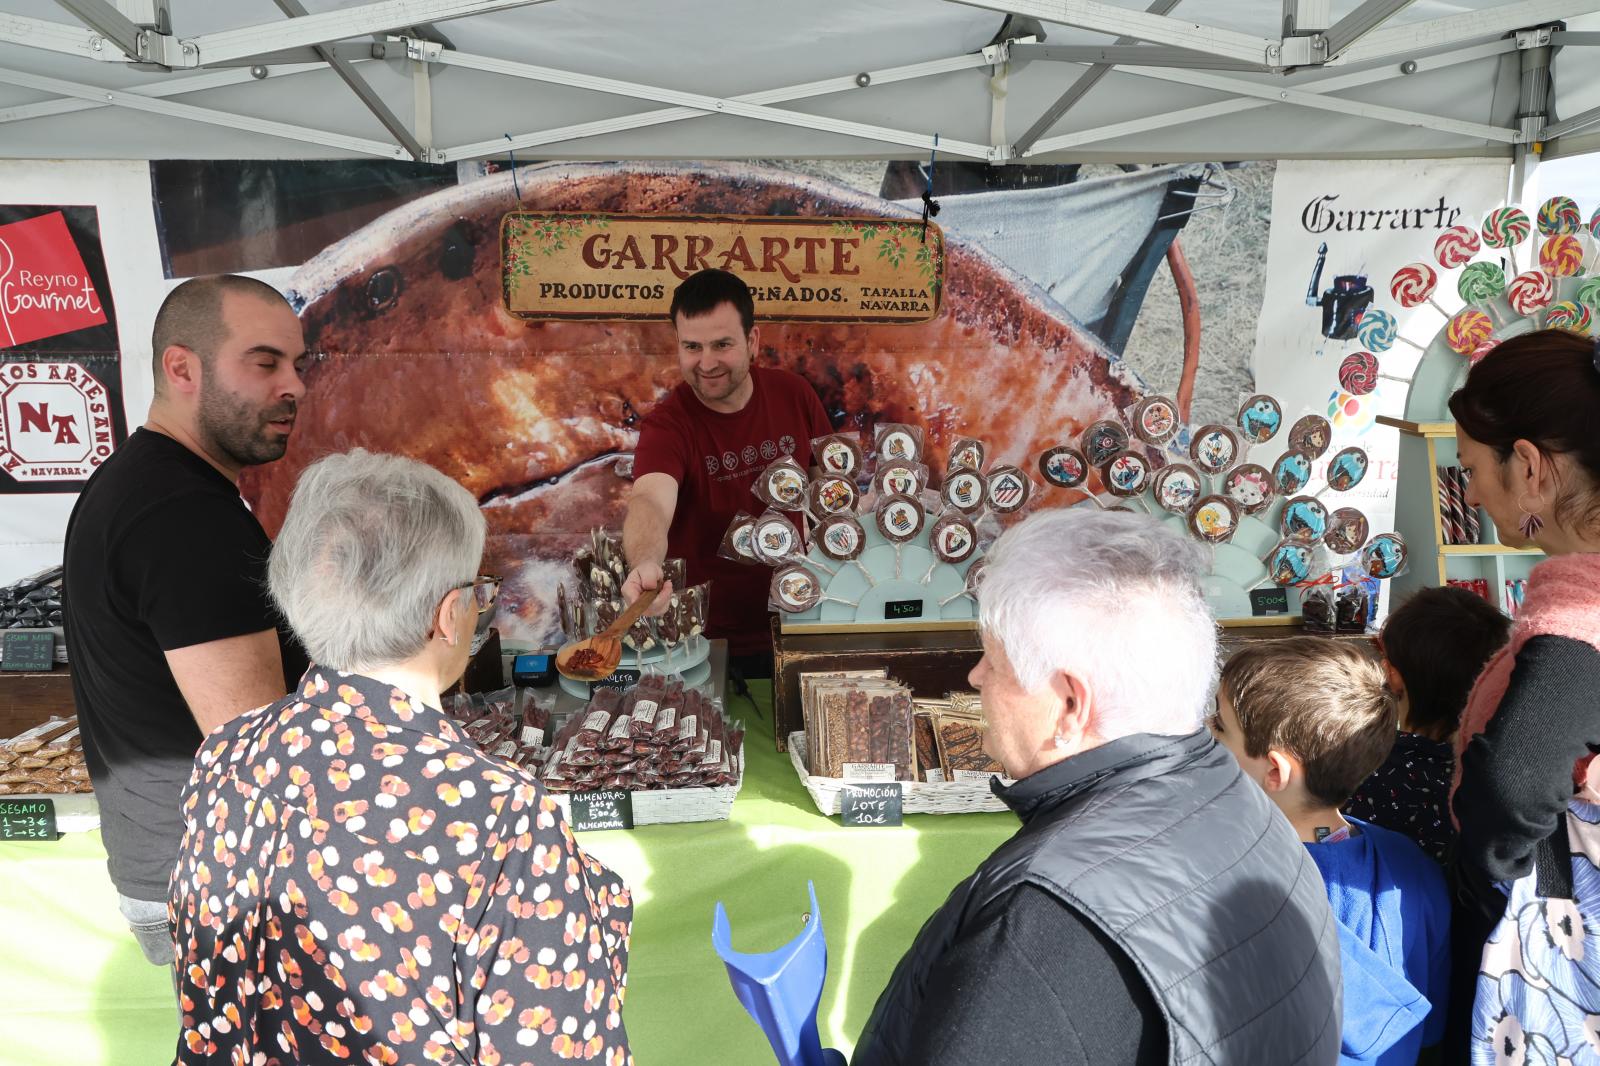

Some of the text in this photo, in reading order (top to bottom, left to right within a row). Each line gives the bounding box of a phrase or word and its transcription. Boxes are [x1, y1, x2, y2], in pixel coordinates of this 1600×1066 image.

[1301, 194, 1461, 234] Garrarte
[581, 233, 860, 284] GARRARTE
[20, 270, 77, 291] Reyno
[4, 276, 101, 314] Gourmet
[539, 282, 664, 300] PRODUCTOS
[860, 287, 929, 299] TAFALLA
[860, 300, 931, 313] NAVARRA
[31, 467, 81, 476] NAVARRA
[573, 791, 626, 802] ALMENDRAS
[846, 786, 898, 798] PROMOCIÓN
[0, 803, 46, 814] SESAMO
[851, 801, 887, 811] LOTE
[3, 816, 11, 827] 1
[578, 820, 624, 831] ALMENDRAK
[3, 828, 13, 838] 2
